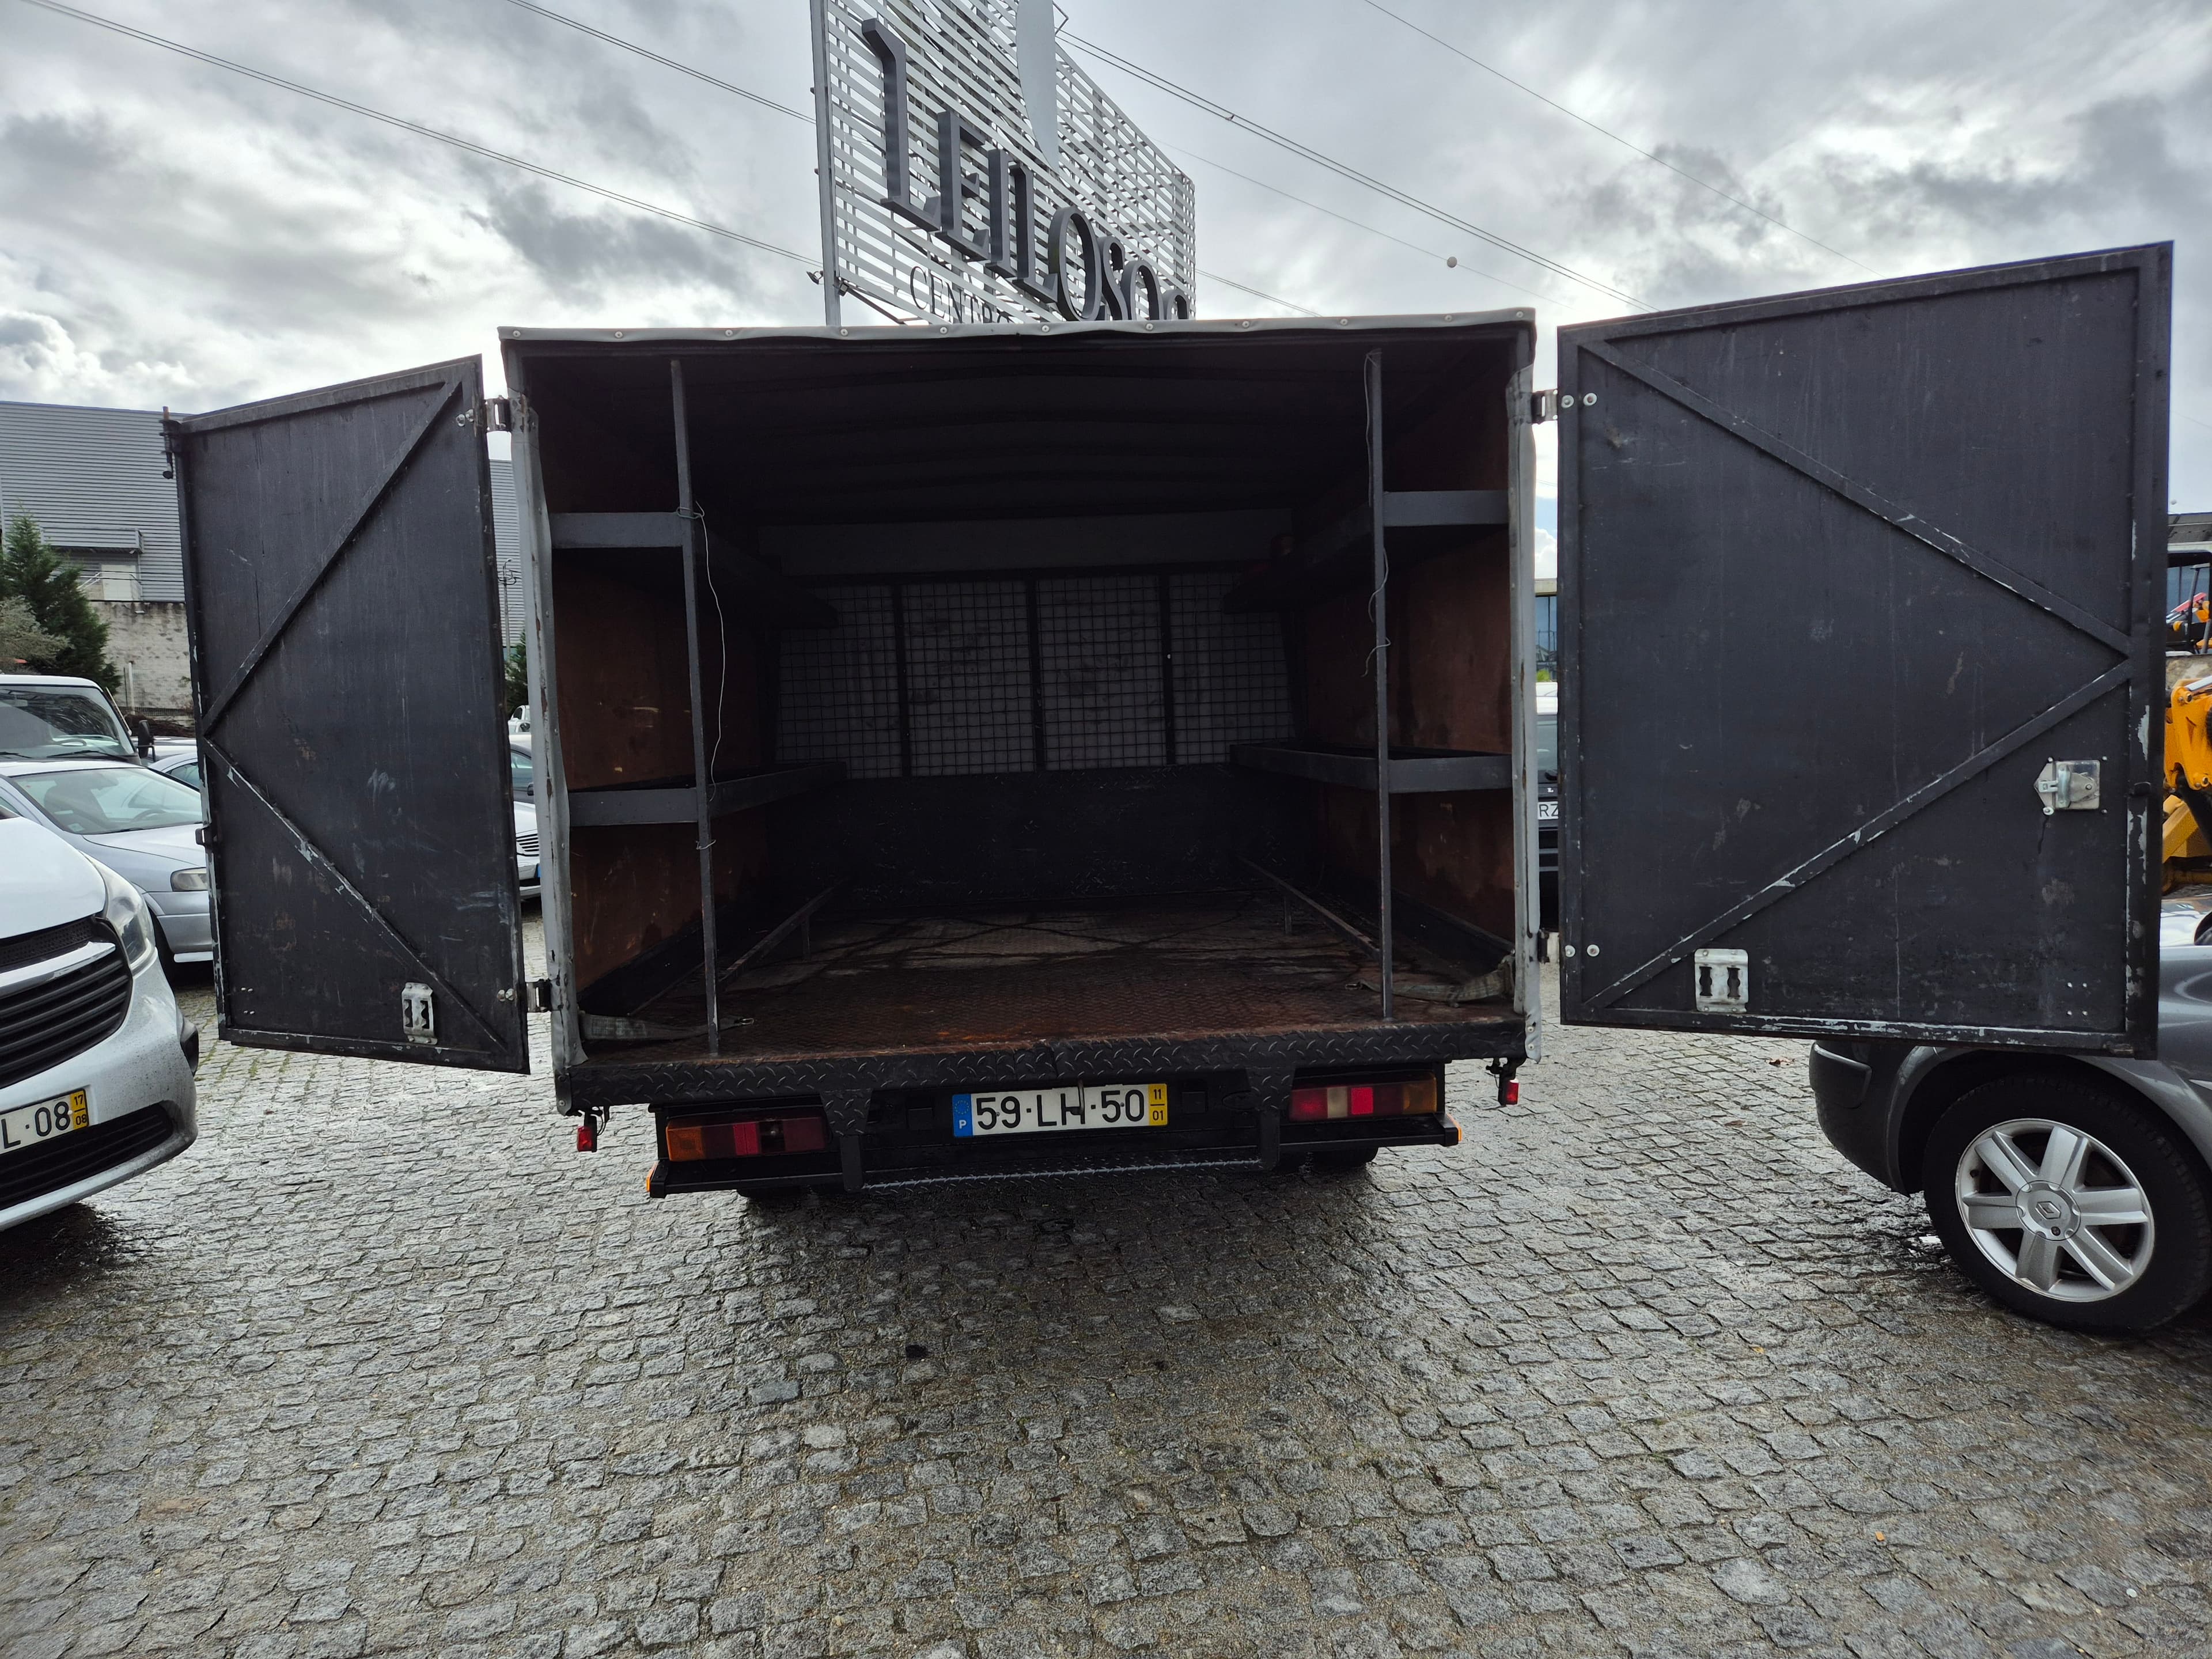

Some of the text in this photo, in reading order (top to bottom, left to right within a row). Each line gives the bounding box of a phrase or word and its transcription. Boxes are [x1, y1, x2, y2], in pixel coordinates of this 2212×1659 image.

[74, 1094, 84, 1105] 17
[1153, 1089, 1161, 1100] 11
[75, 1114, 86, 1125] 08
[1153, 1110, 1163, 1121] 01
[959, 1119, 967, 1129] P
